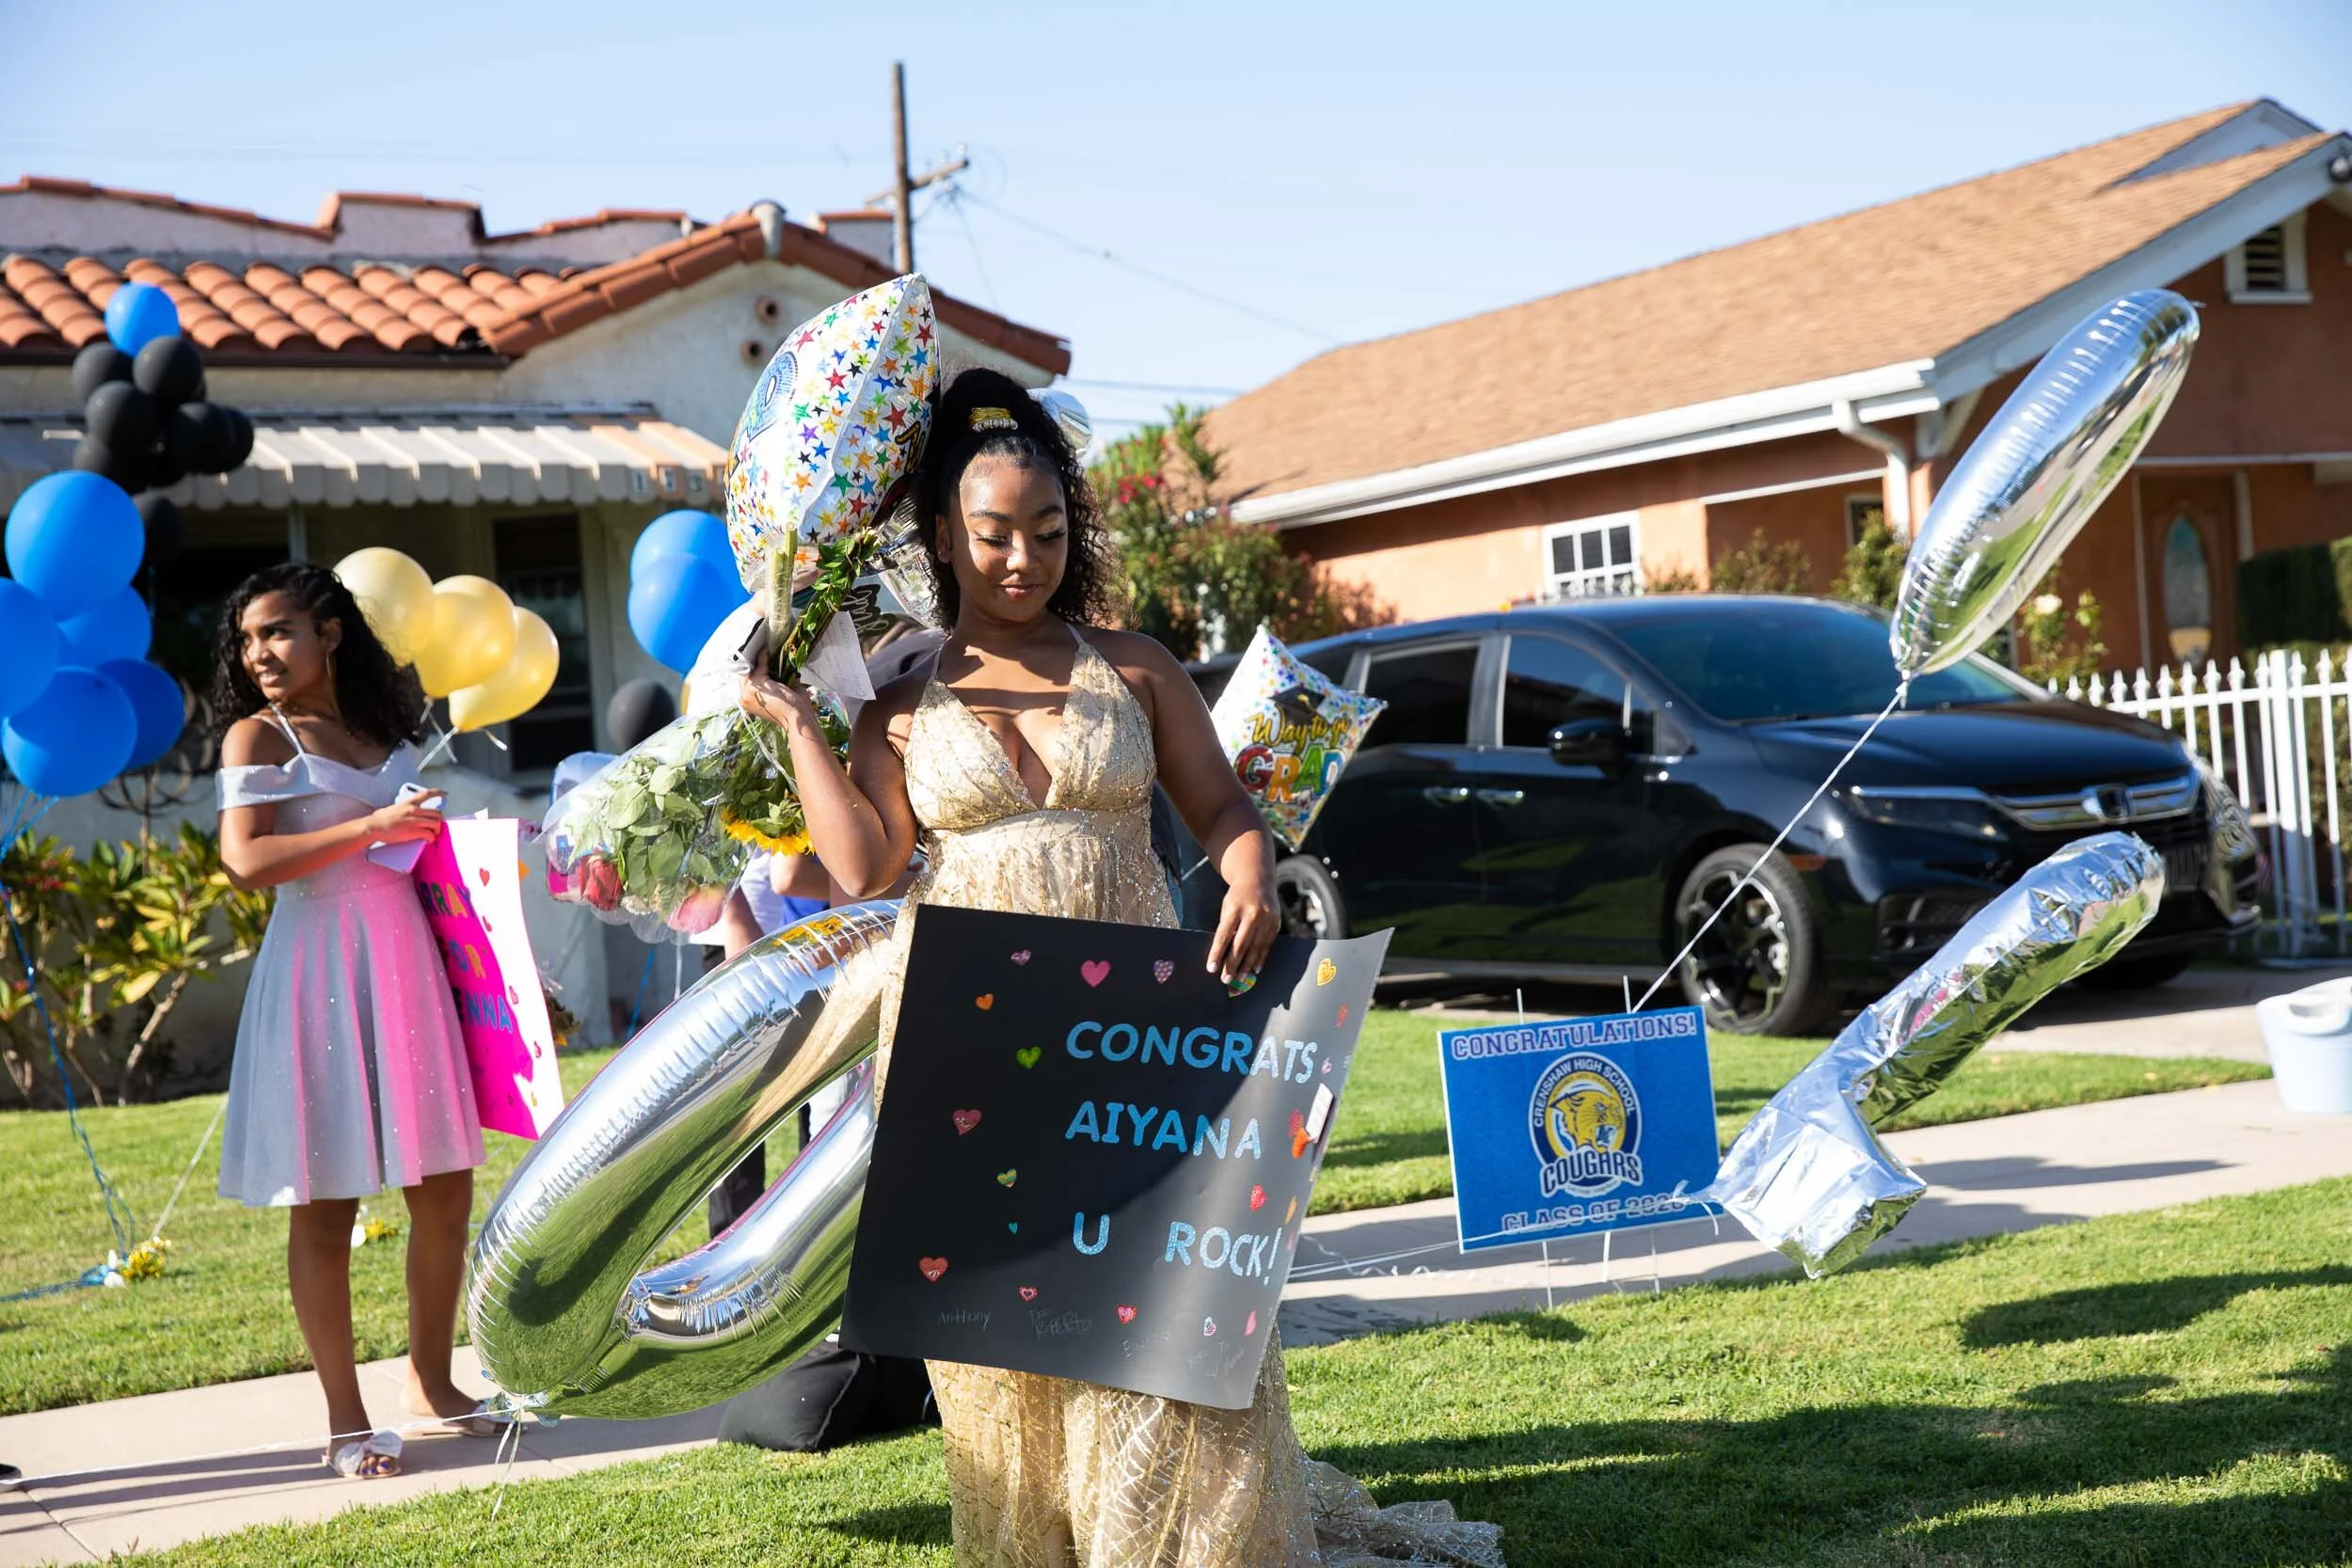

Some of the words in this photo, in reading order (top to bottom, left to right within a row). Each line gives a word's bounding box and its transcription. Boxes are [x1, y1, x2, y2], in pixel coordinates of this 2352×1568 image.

[1244, 705, 1309, 755] Way
[1233, 742, 1347, 803] GRAD
[1066, 1020, 1318, 1085] CONGRATS
[1452, 1013, 1697, 1059] CONGRATULATIONS!
[1534, 1061, 1572, 1128] CRENSHAW
[1574, 1057, 1603, 1072] HIGH
[1602, 1066, 1637, 1117] SCHOOL
[1065, 1101, 1262, 1160] AIYANA
[1542, 1148, 1642, 1196] COUGARS
[1502, 1205, 1583, 1233] CLASS
[1588, 1200, 1620, 1223] OF
[1073, 1212, 1109, 1256] U
[1164, 1220, 1283, 1287] ROCK!
